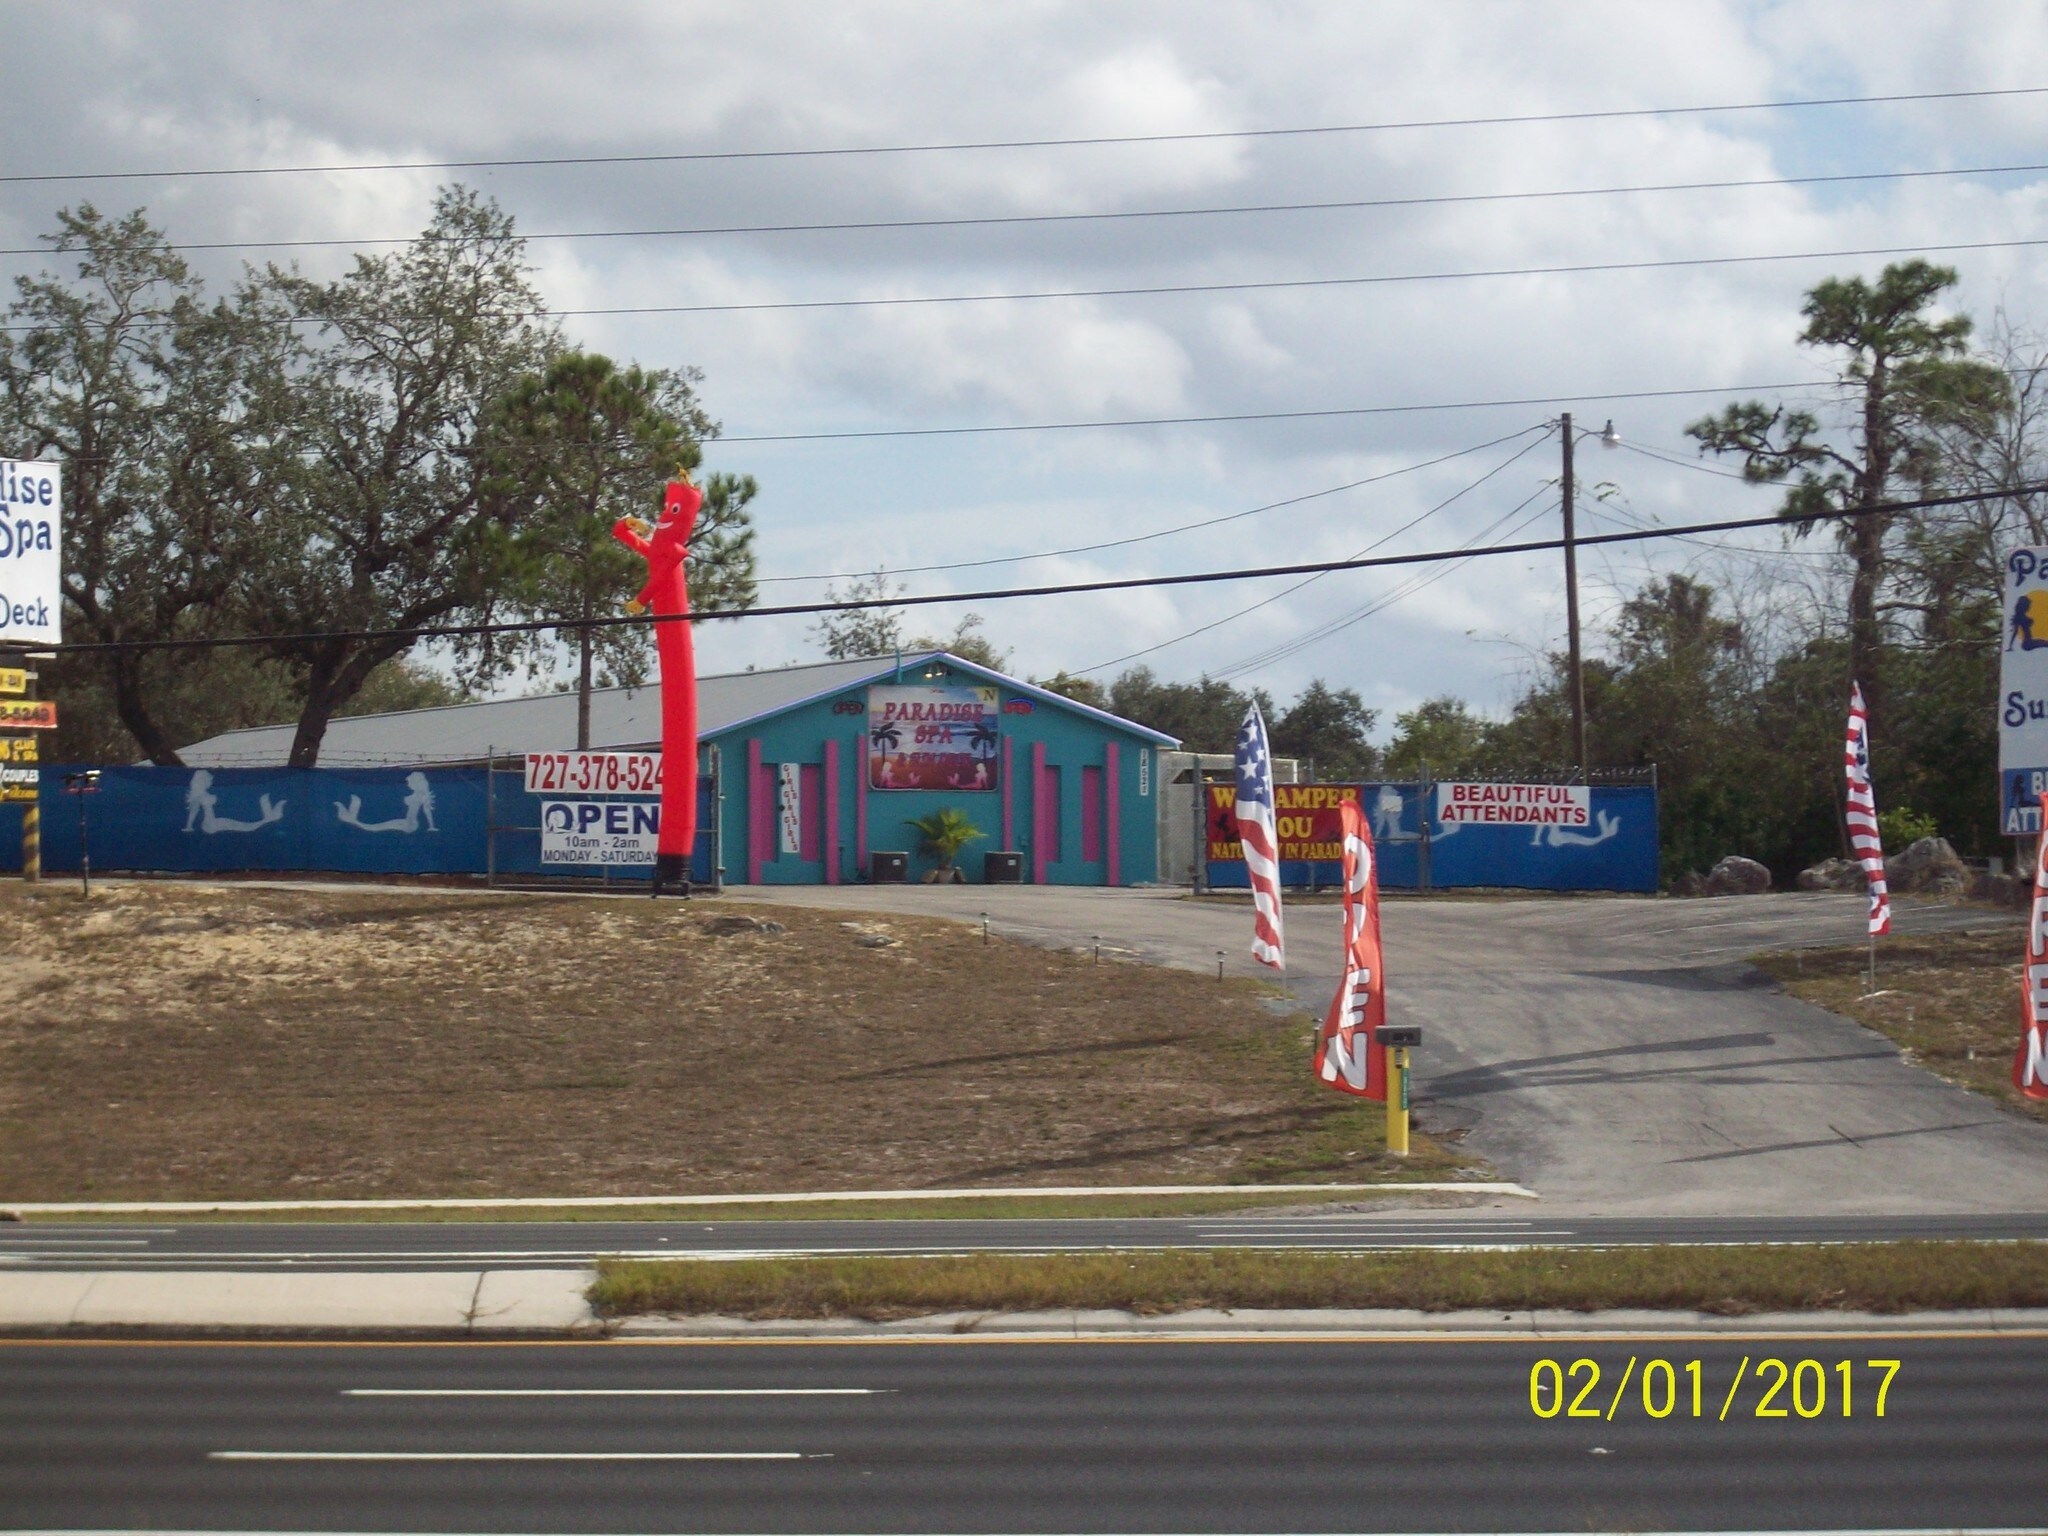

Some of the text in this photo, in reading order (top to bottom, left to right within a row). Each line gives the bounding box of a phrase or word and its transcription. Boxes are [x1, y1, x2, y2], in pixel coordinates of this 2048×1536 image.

[883, 702, 984, 721] PARADISE
[914, 724, 953, 744] SPA
[528, 754, 664, 791] 727-378-524
[1453, 785, 1575, 804] BEAUTIFUL
[545, 803, 660, 835] OPEN
[1441, 804, 1587, 824] ATTENDANTS
[565, 836, 600, 848] 10am
[612, 836, 640, 848] 2am
[544, 850, 592, 862] MONDAY
[601, 851, 659, 863] SATURDAY
